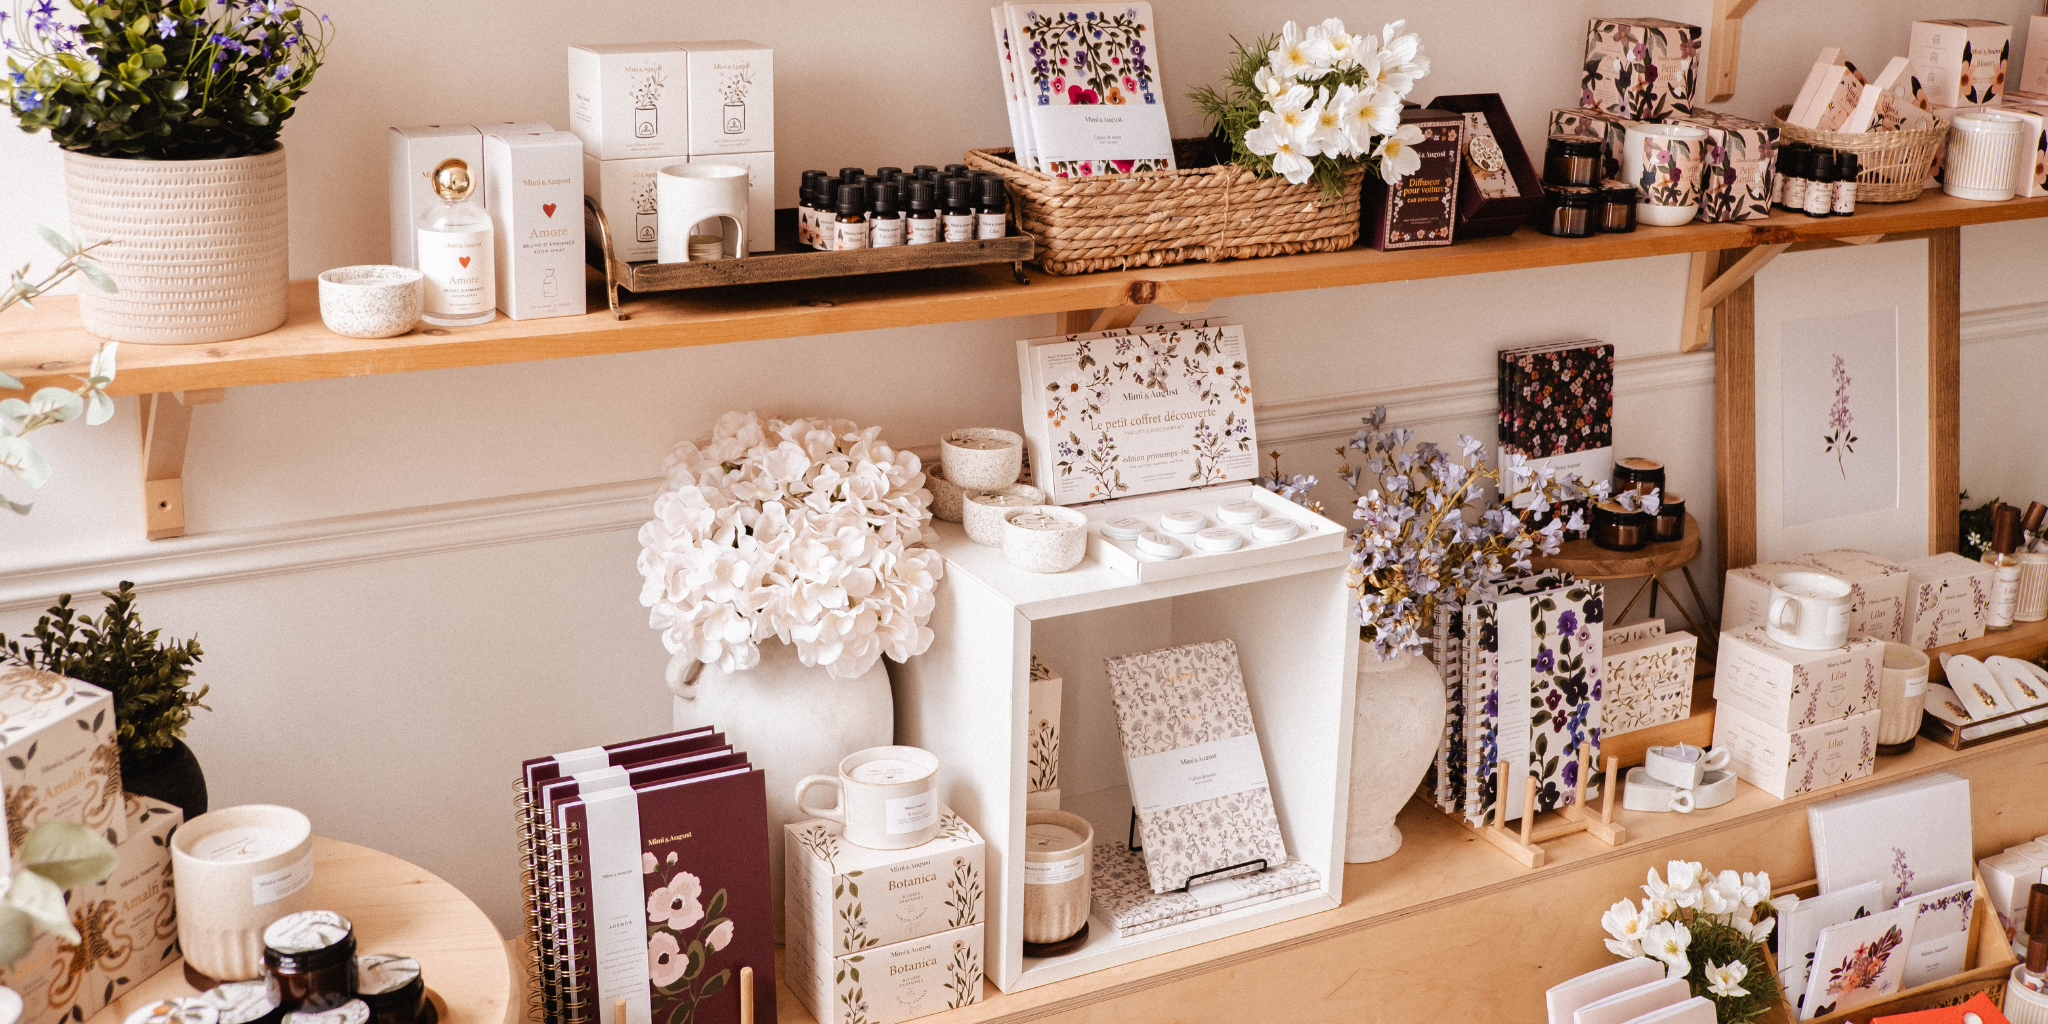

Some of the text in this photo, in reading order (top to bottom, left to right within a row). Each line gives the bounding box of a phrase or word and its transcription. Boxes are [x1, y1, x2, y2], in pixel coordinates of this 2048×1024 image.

[1662, 64, 1676, 72] Petit
[1426, 150, 1446, 159] August
[1741, 166, 1755, 174] Petit
[523, 178, 540, 186] Mimi
[547, 177, 572, 186] August
[1409, 178, 1440, 187] Diffuseur
[1403, 186, 1445, 197] pour voiture
[529, 228, 568, 239] Amore
[449, 276, 480, 284] Amore
[1122, 392, 1143, 401] Mimi
[1150, 388, 1178, 398] August
[1090, 408, 1216, 433] Le petit coffret découverte
[1122, 454, 1144, 464] édition
[1870, 610, 1886, 620] Lilas
[1831, 670, 1846, 681] Lilas
[1828, 739, 1844, 750] Lilas
[43, 766, 86, 802] Amalfi
[648, 836, 664, 846] Mimi
[670, 832, 692, 841] August
[890, 864, 905, 873] Mimi
[911, 860, 932, 868] August
[888, 873, 937, 891] Botanica
[122, 880, 159, 915] Amalfi
[608, 920, 632, 930] AGENDA
[890, 950, 906, 958] Mimi
[910, 944, 932, 953] August
[890, 958, 938, 976] Botanica
[902, 974, 920, 982] BOUGIE
